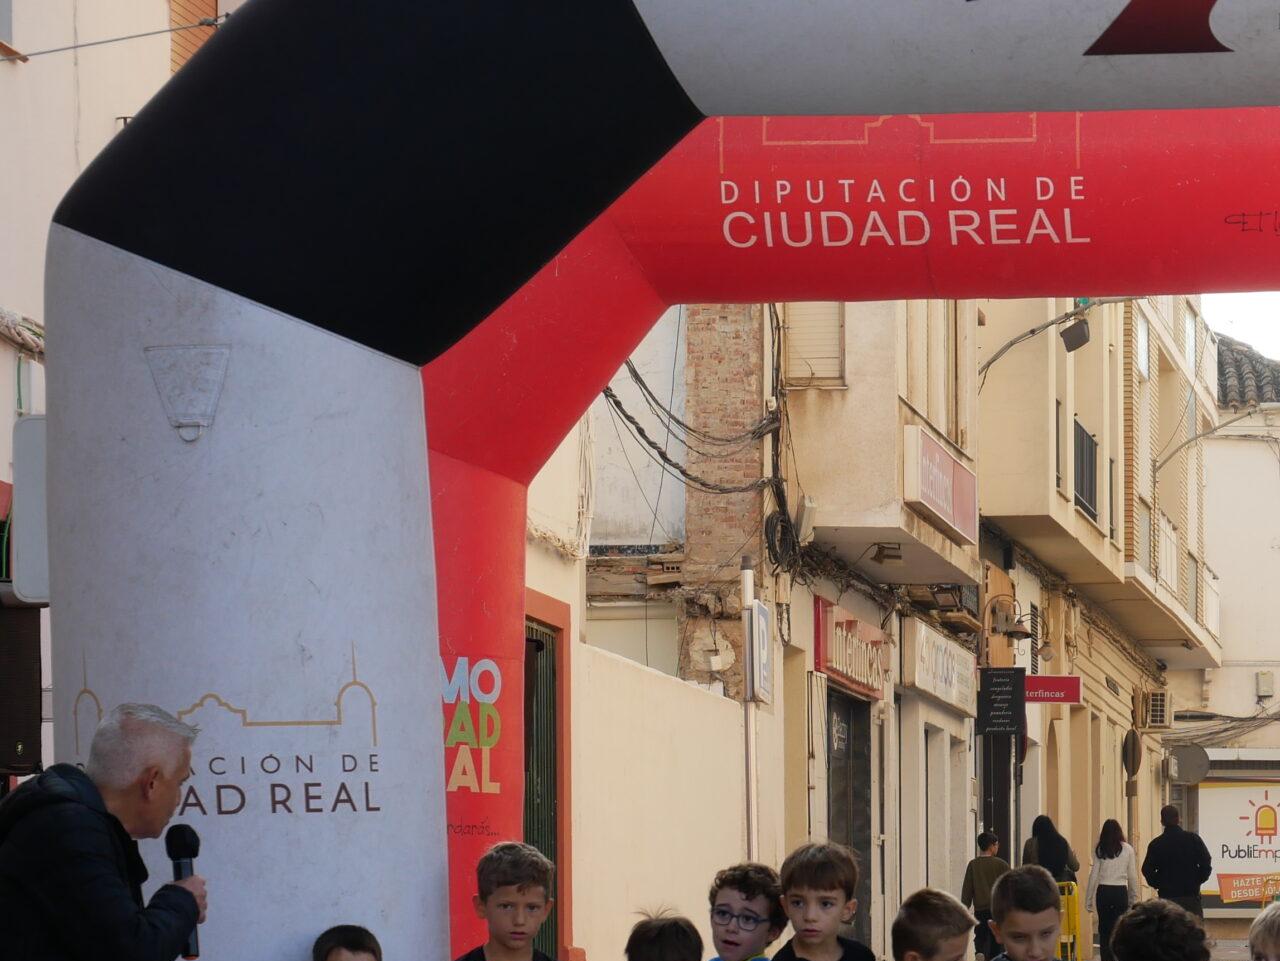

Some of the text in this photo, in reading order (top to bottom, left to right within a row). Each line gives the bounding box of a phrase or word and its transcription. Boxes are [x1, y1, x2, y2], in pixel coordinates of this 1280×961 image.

[720, 175, 1085, 204] DIPUTACIÓN DE
[722, 207, 1091, 248] CIUDAD REAL
[188, 752, 379, 775] CIÓN DE
[270, 781, 381, 814] REAL
[1231, 888, 1261, 899] DESDE
[1232, 875, 1261, 888] HAZTE
